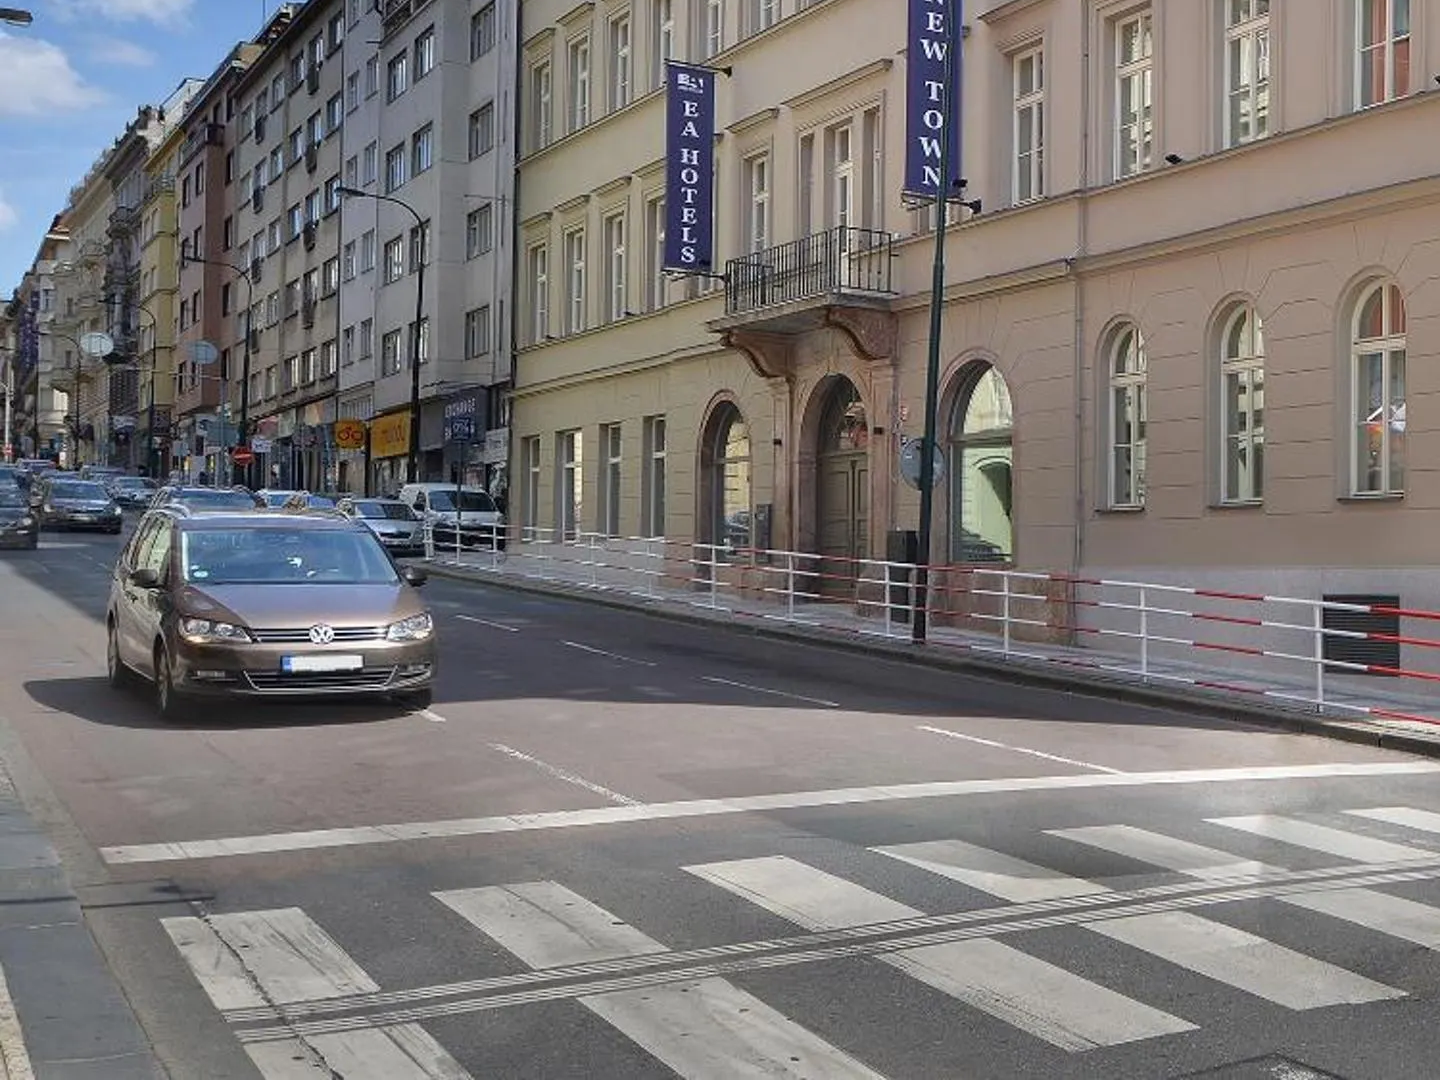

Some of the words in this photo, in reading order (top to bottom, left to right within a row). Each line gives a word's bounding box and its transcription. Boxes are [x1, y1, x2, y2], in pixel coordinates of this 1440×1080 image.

[680, 99, 700, 139] EA
[918, 79, 944, 187] TOWN
[679, 147, 699, 263] HOTELS
